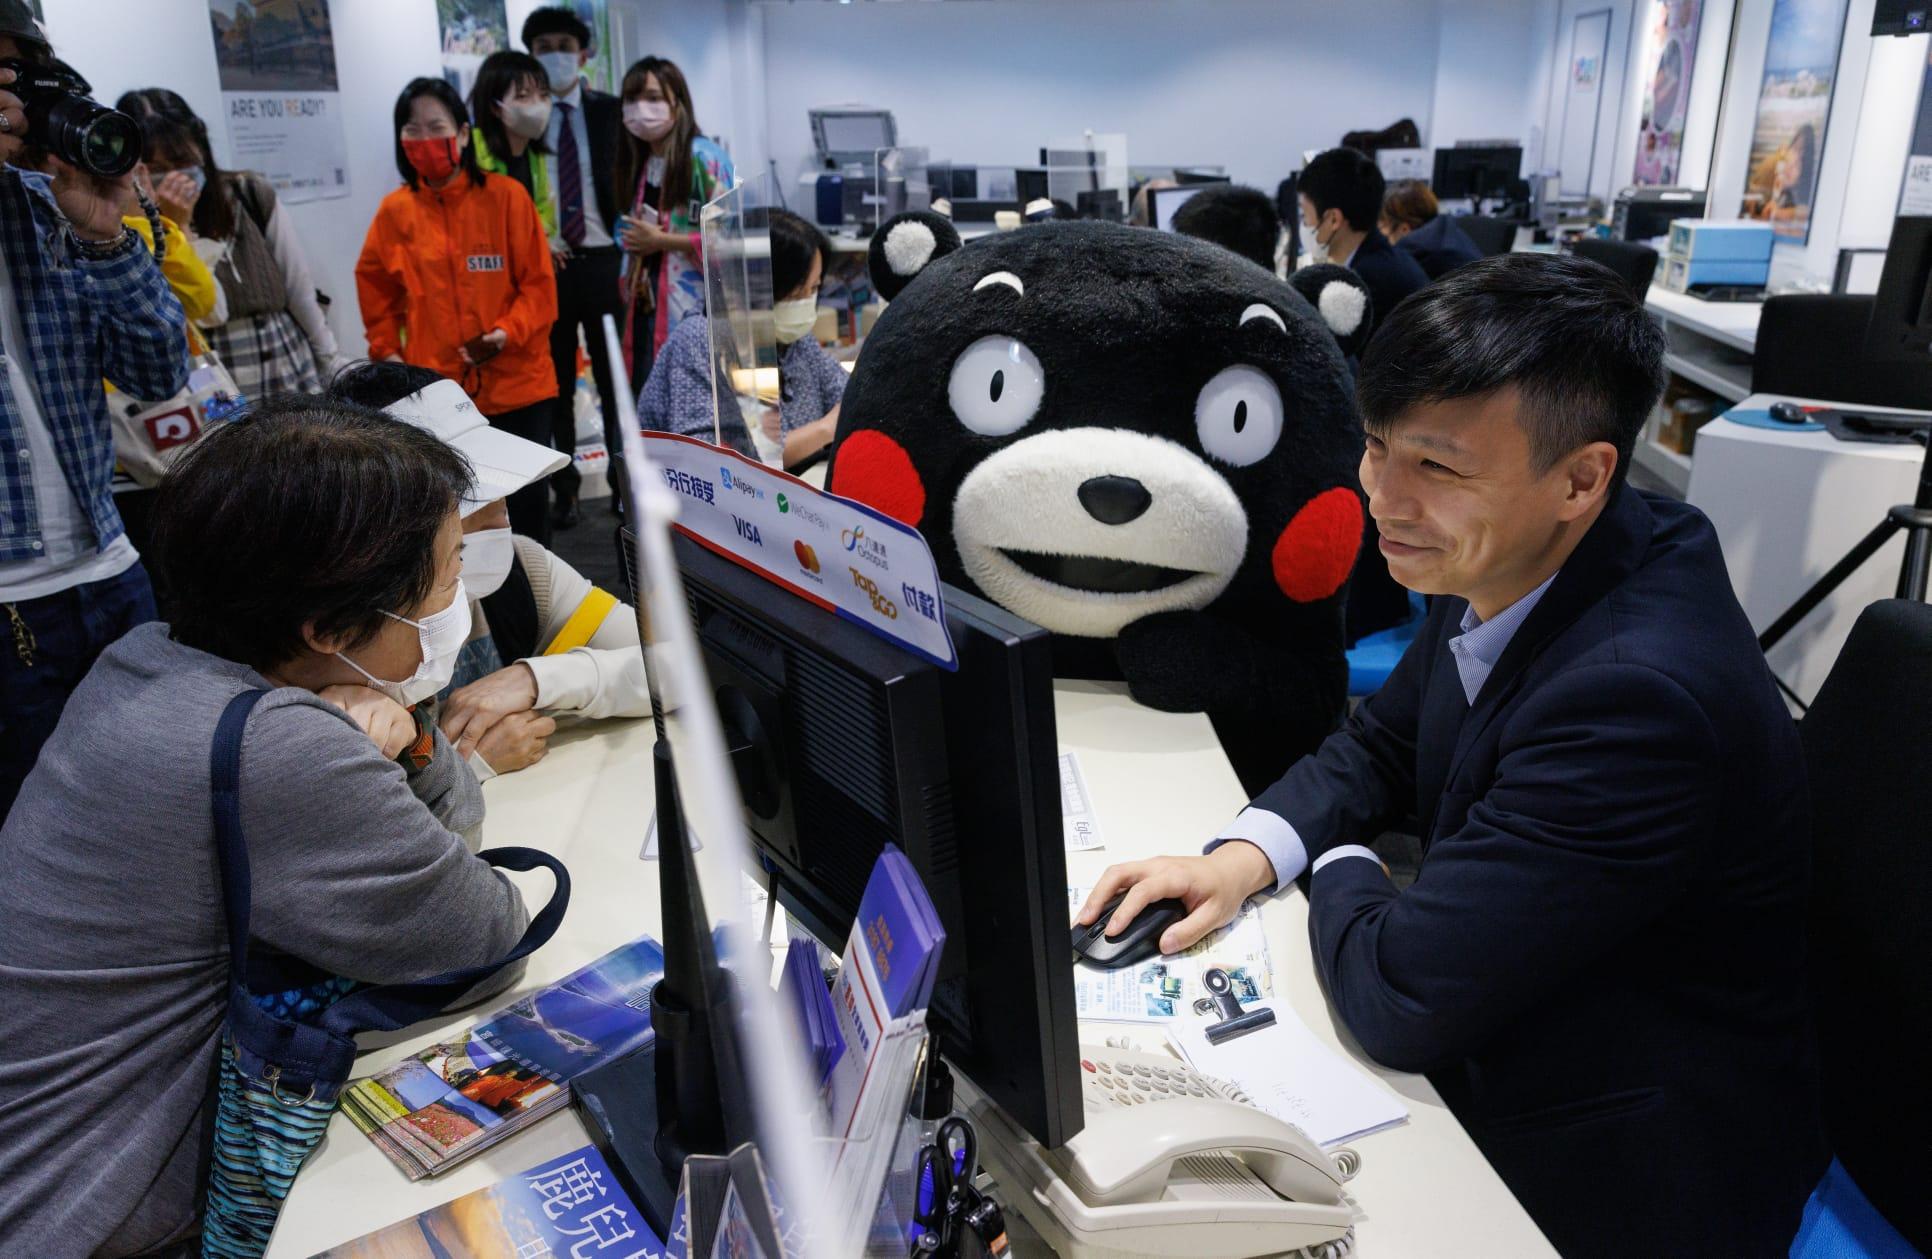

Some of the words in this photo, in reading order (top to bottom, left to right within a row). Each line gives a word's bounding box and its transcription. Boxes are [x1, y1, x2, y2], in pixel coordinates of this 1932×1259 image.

[34, 79, 60, 88] FUJIFILM
[231, 99, 256, 119] ARE
[258, 98, 284, 118] YOU
[284, 97, 326, 117] READY?
[732, 513, 763, 547] VISA
[902, 580, 938, 624] 付款
[525, 1157, 664, 1259] 鹿兒
